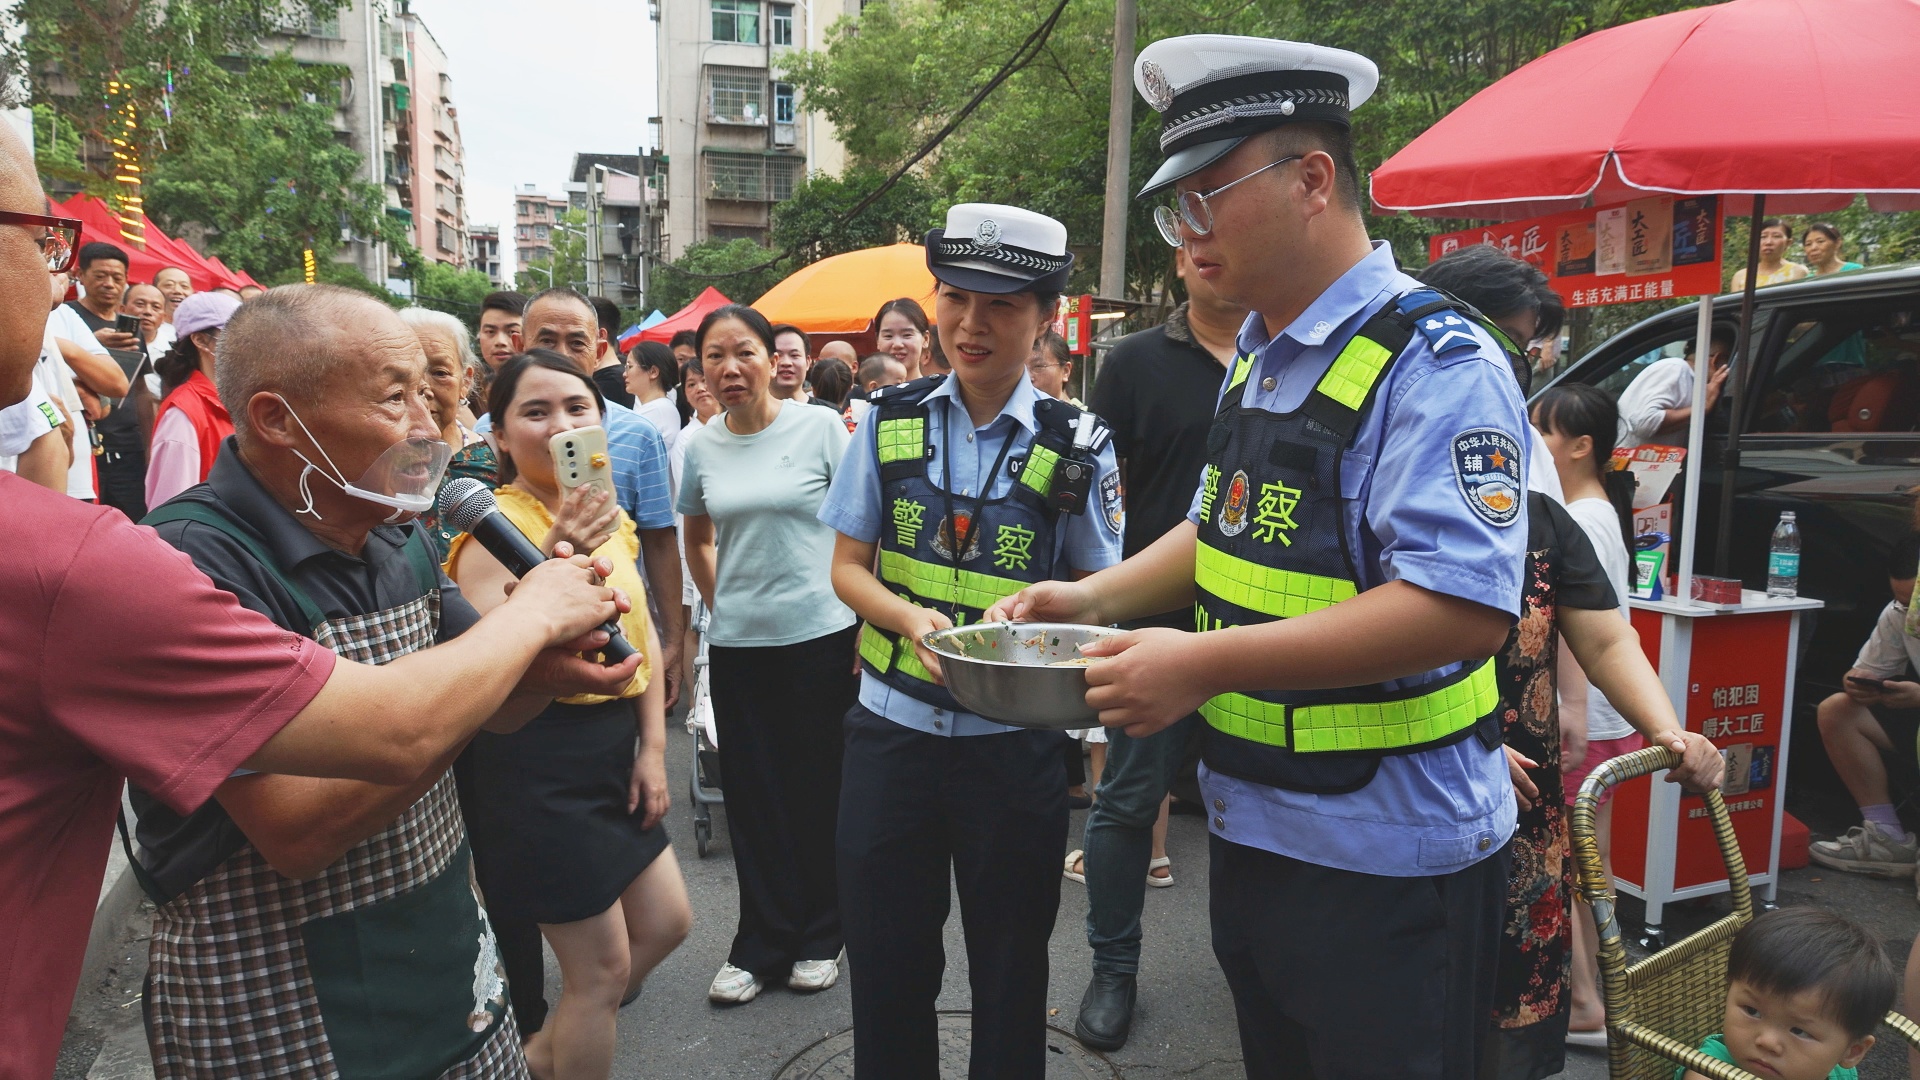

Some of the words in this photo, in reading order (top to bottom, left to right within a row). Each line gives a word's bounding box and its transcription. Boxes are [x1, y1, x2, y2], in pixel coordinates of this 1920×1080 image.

[1631, 210, 1648, 257] 大工匠
[1696, 208, 1710, 245] 大工匠
[1572, 279, 1674, 306] 生活充满正能量
[1457, 434, 1518, 460] 中华人民共和国
[1464, 454, 1483, 471] 辅
[1200, 464, 1221, 523] 警
[1252, 480, 1302, 547] 察
[893, 498, 926, 548] 警
[993, 524, 1035, 571] 察
[1713, 685, 1759, 708] 怕犯困
[1703, 714, 1764, 738] 嚼大工匠
